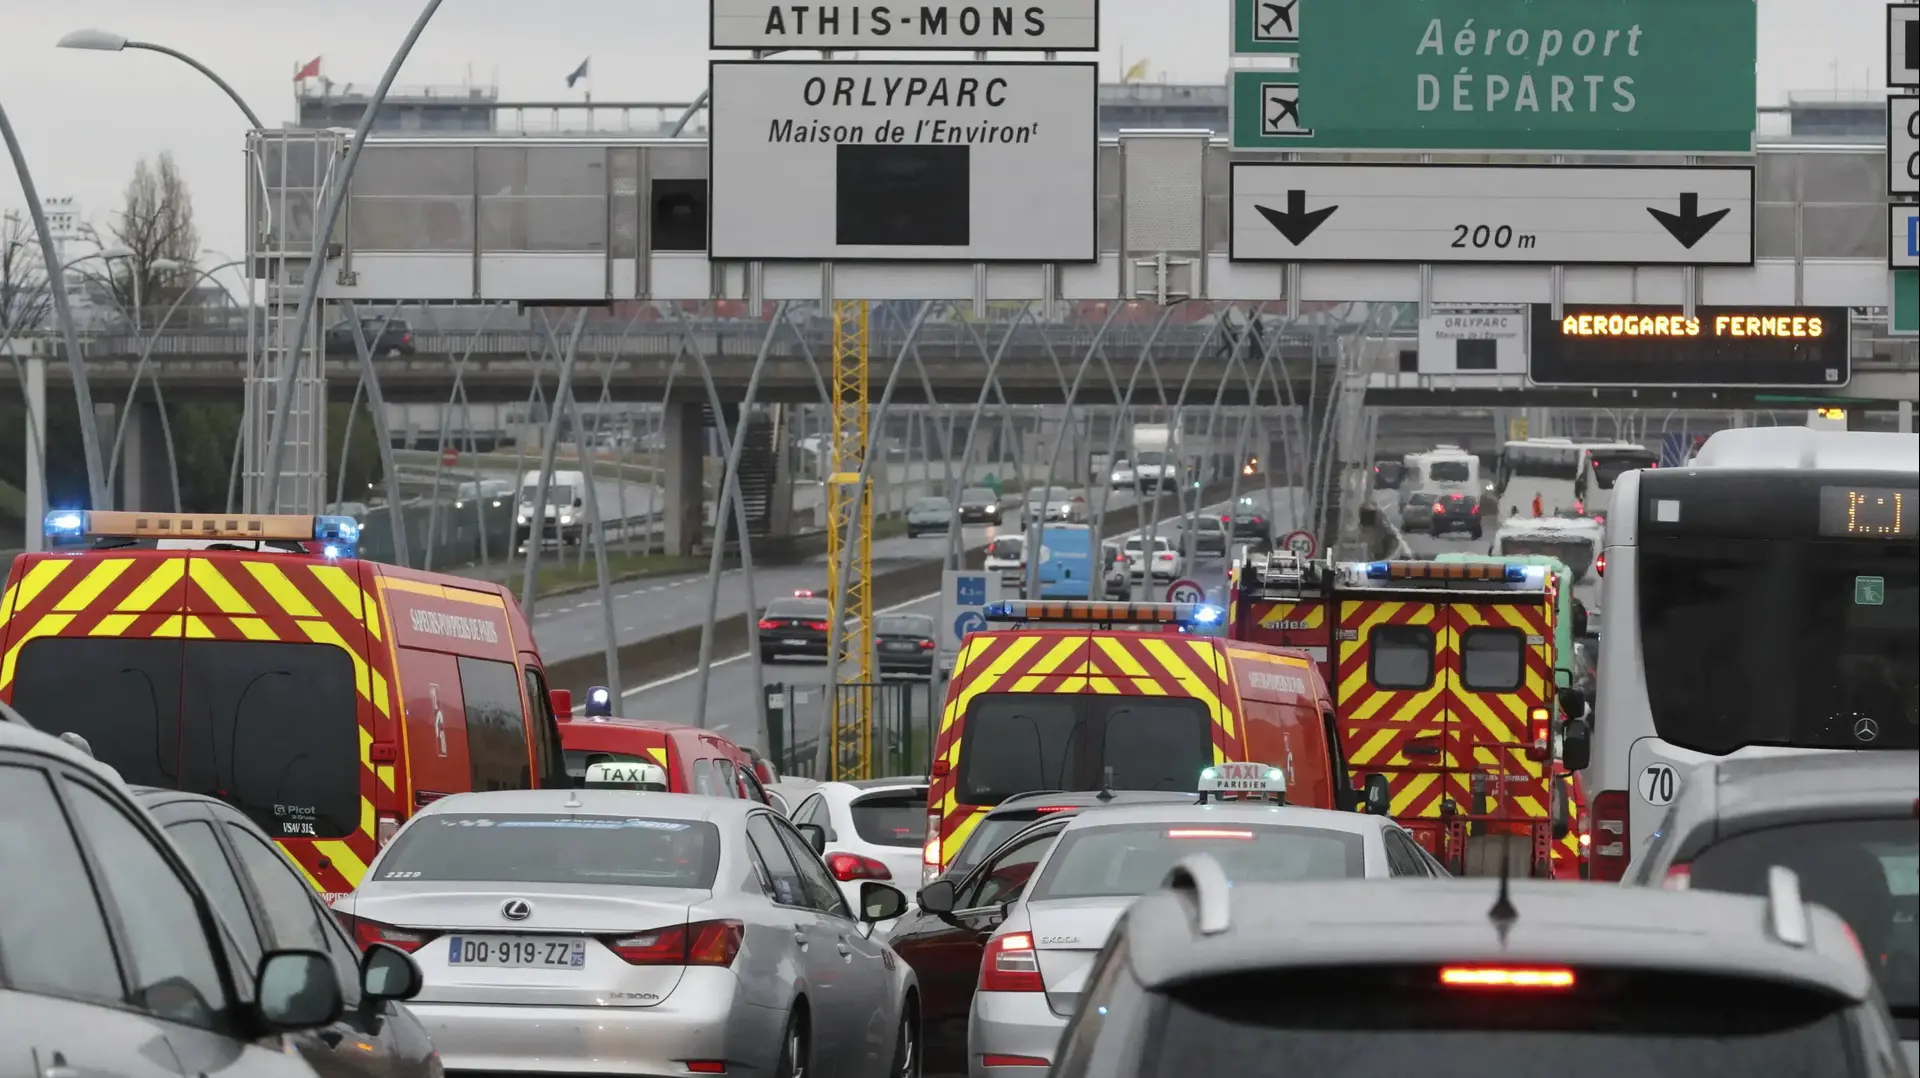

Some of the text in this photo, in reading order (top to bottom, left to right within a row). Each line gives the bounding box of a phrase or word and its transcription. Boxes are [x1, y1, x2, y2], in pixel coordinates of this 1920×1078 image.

[764, 6, 1046, 37] ATHIS-MONS
[1416, 18, 1644, 67] Aéroport
[803, 76, 1009, 108] ORLYPARC
[1416, 67, 1637, 112] DÉPARTS
[768, 119, 863, 143] Maison
[874, 119, 905, 144] de
[1450, 224, 1537, 249] 200 m
[1445, 317, 1508, 328] ORLYPARC
[1563, 314, 1824, 337] AEROGARES FERMEES
[1175, 590, 1198, 604] 50
[601, 768, 646, 781] TAXI
[1223, 765, 1259, 779] TAXI
[1647, 767, 1673, 802] 70
[288, 805, 316, 814] Picot
[283, 822, 313, 834] VSAV 315
[464, 941, 569, 965] DQ-919-ZZ
[571, 954, 584, 966] 75
